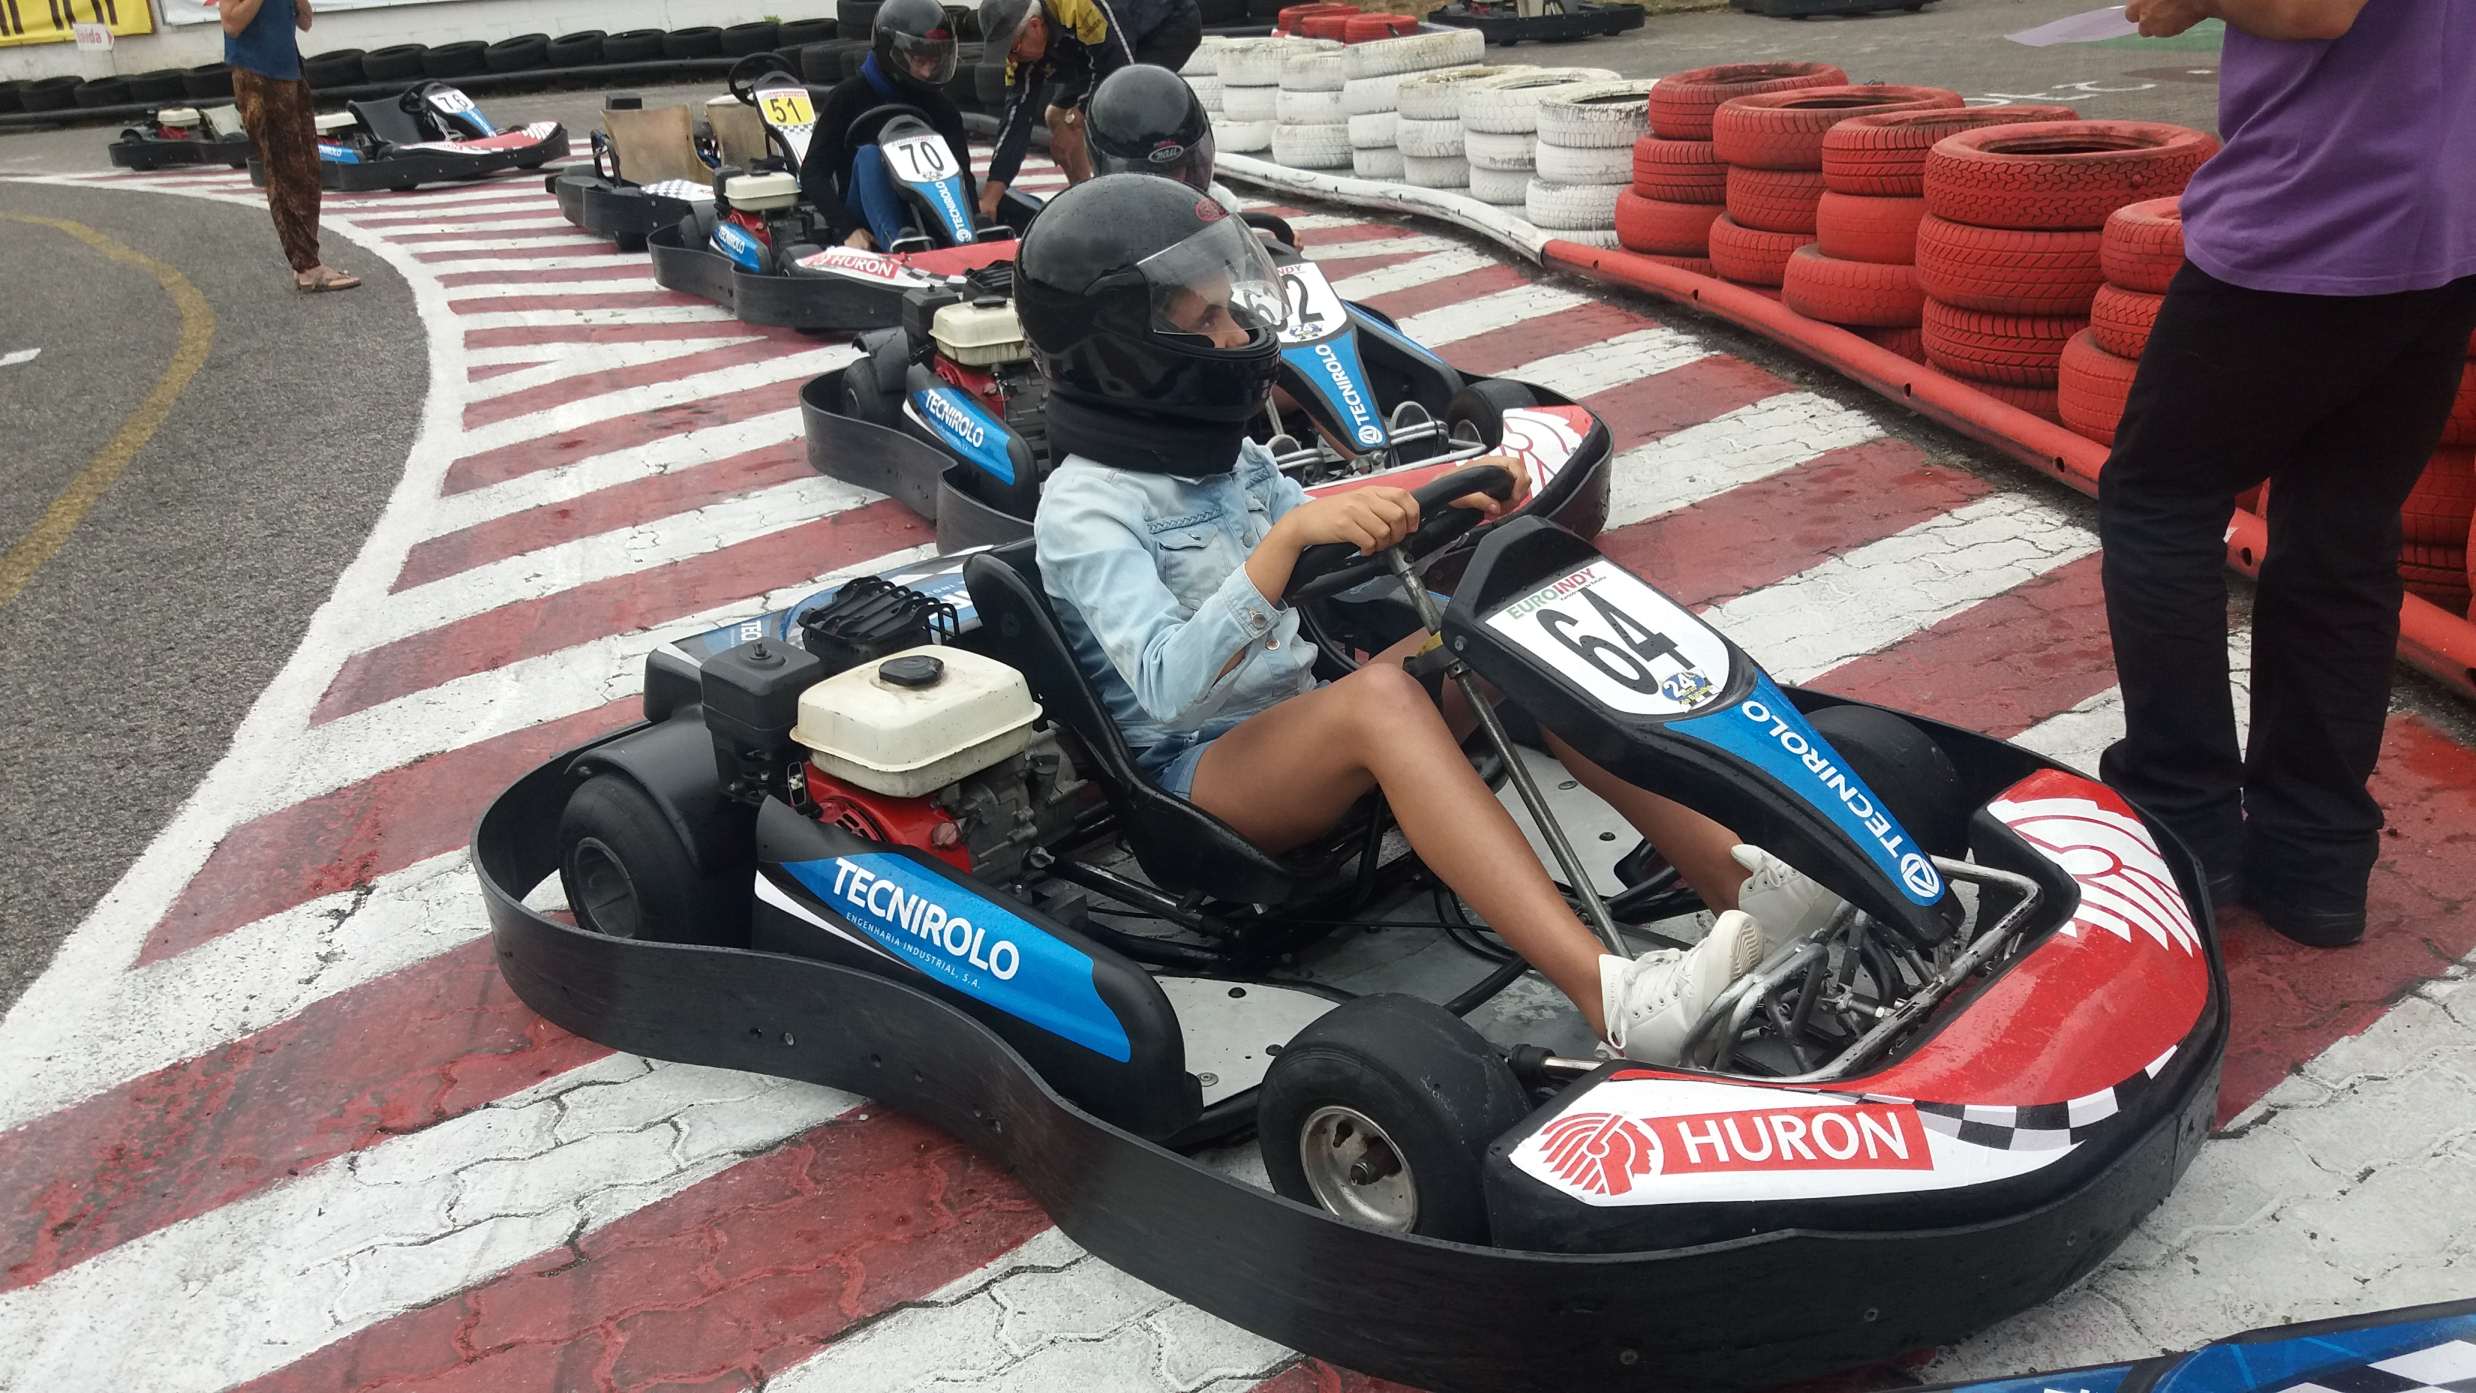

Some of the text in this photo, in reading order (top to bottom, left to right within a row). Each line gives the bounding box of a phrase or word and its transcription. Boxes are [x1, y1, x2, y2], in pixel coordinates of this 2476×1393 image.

[437, 95, 468, 110] 76
[770, 97, 802, 123] 51
[899, 141, 944, 174] 70
[831, 254, 893, 277] HURON
[1315, 344, 1370, 426] TECNIROLO
[926, 388, 984, 448] TECNIROLO
[1506, 568, 1596, 620] EUROINDY
[1536, 586, 1696, 695] 64
[1742, 700, 1903, 858] TECNIROLO
[833, 857, 1020, 980] TECNIROLO
[846, 912, 901, 946] ENGENHARIA
[963, 973, 982, 990] S.A.
[1677, 1111, 1909, 1164] HURON
